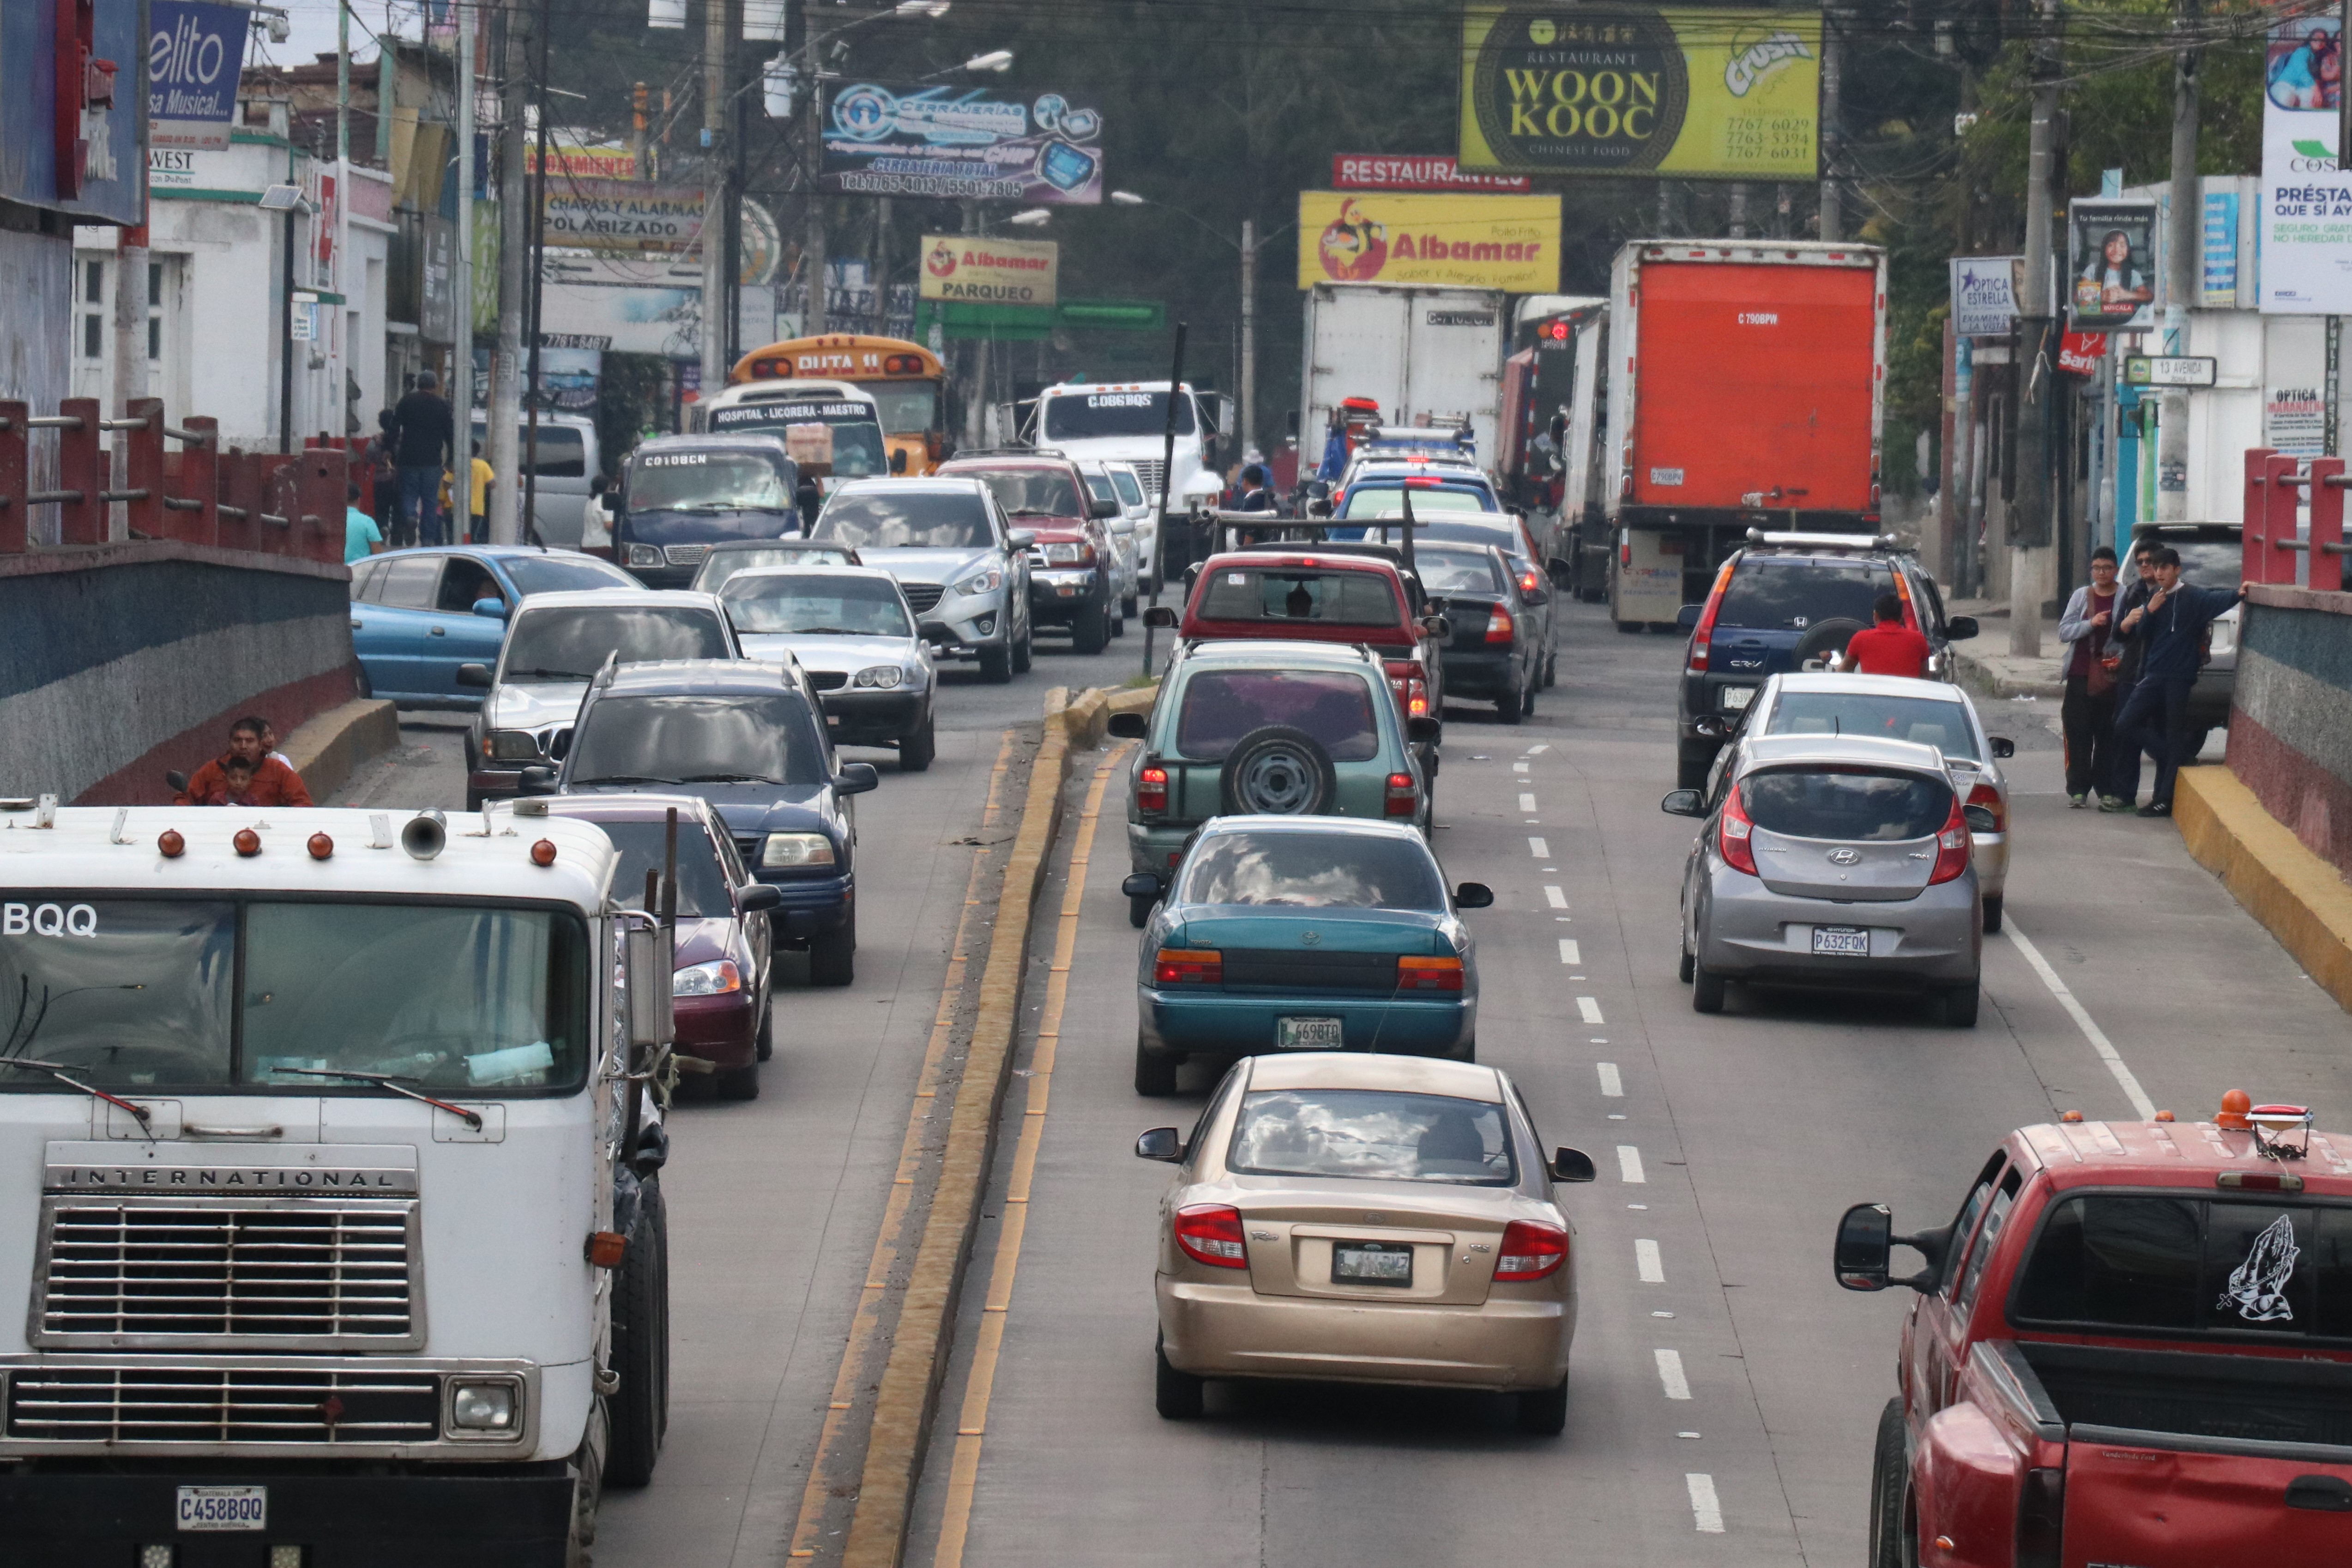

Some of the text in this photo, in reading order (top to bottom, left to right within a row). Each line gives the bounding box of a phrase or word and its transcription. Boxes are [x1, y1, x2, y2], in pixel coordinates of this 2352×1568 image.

[149, 14, 223, 84] elito
[1527, 51, 1637, 66] RESTAURANT
[1503, 68, 1660, 105] WOON
[1510, 103, 1655, 139] KOOC
[1727, 118, 1809, 130] 7767-6029
[1529, 145, 1630, 156] CHINESE FOOD
[1726, 145, 1808, 158] 7767-6031
[149, 150, 194, 170] WEST
[527, 153, 635, 175] AOJAMIENTO
[1341, 159, 1524, 186] RESTAURA
[627, 202, 704, 218] ALARMAS
[2274, 205, 2307, 216] QUE
[2314, 201, 2327, 216] SÍ
[2274, 223, 2318, 234] SEGURO
[2274, 235, 2289, 243] NO
[2293, 234, 2343, 243] HEREDAR
[1390, 233, 1541, 262] Albamar
[961, 251, 1049, 271] Albamar
[942, 282, 1033, 300] PARQUEO
[1973, 278, 2009, 291] OPTICA
[1967, 291, 2009, 305] ESTRELLA
[2160, 361, 2202, 374] 13 AVENIDA
[2276, 389, 2316, 402] OPTICA
[717, 404, 866, 422] HOSPITAL LICORERA MAESTRO
[3, 903, 97, 939] BQQ
[69, 1170, 392, 1187] INTERNATIONAL
[1251, 1231, 1279, 1241] Rio
[181, 1498, 262, 1520] C458BQQ
